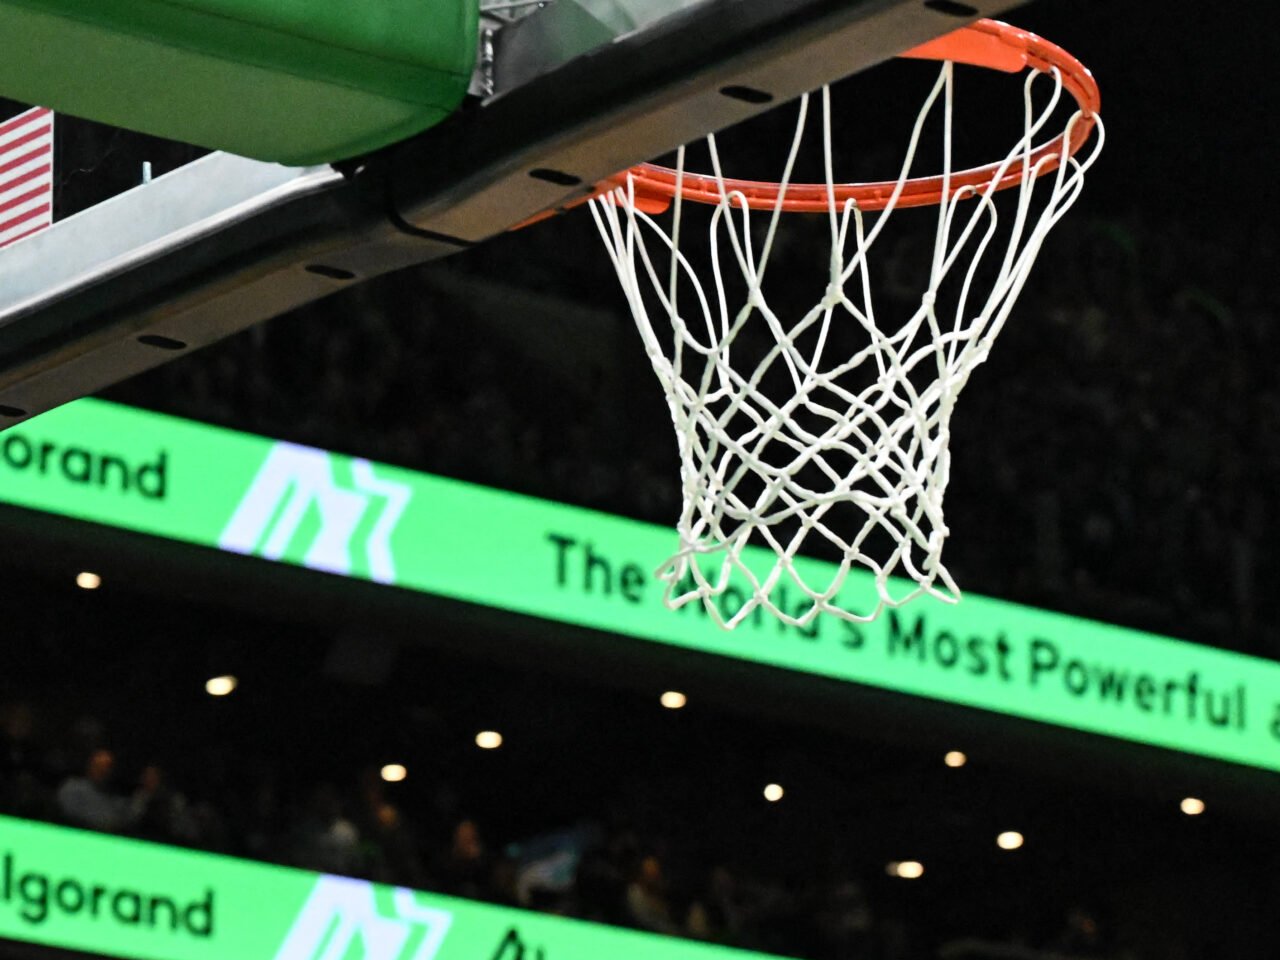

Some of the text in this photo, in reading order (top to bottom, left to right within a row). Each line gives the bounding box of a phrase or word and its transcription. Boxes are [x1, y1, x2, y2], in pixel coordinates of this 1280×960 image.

[548, 534, 647, 604] The
[887, 608, 1012, 682] Most
[1029, 638, 1245, 729] Powerful
